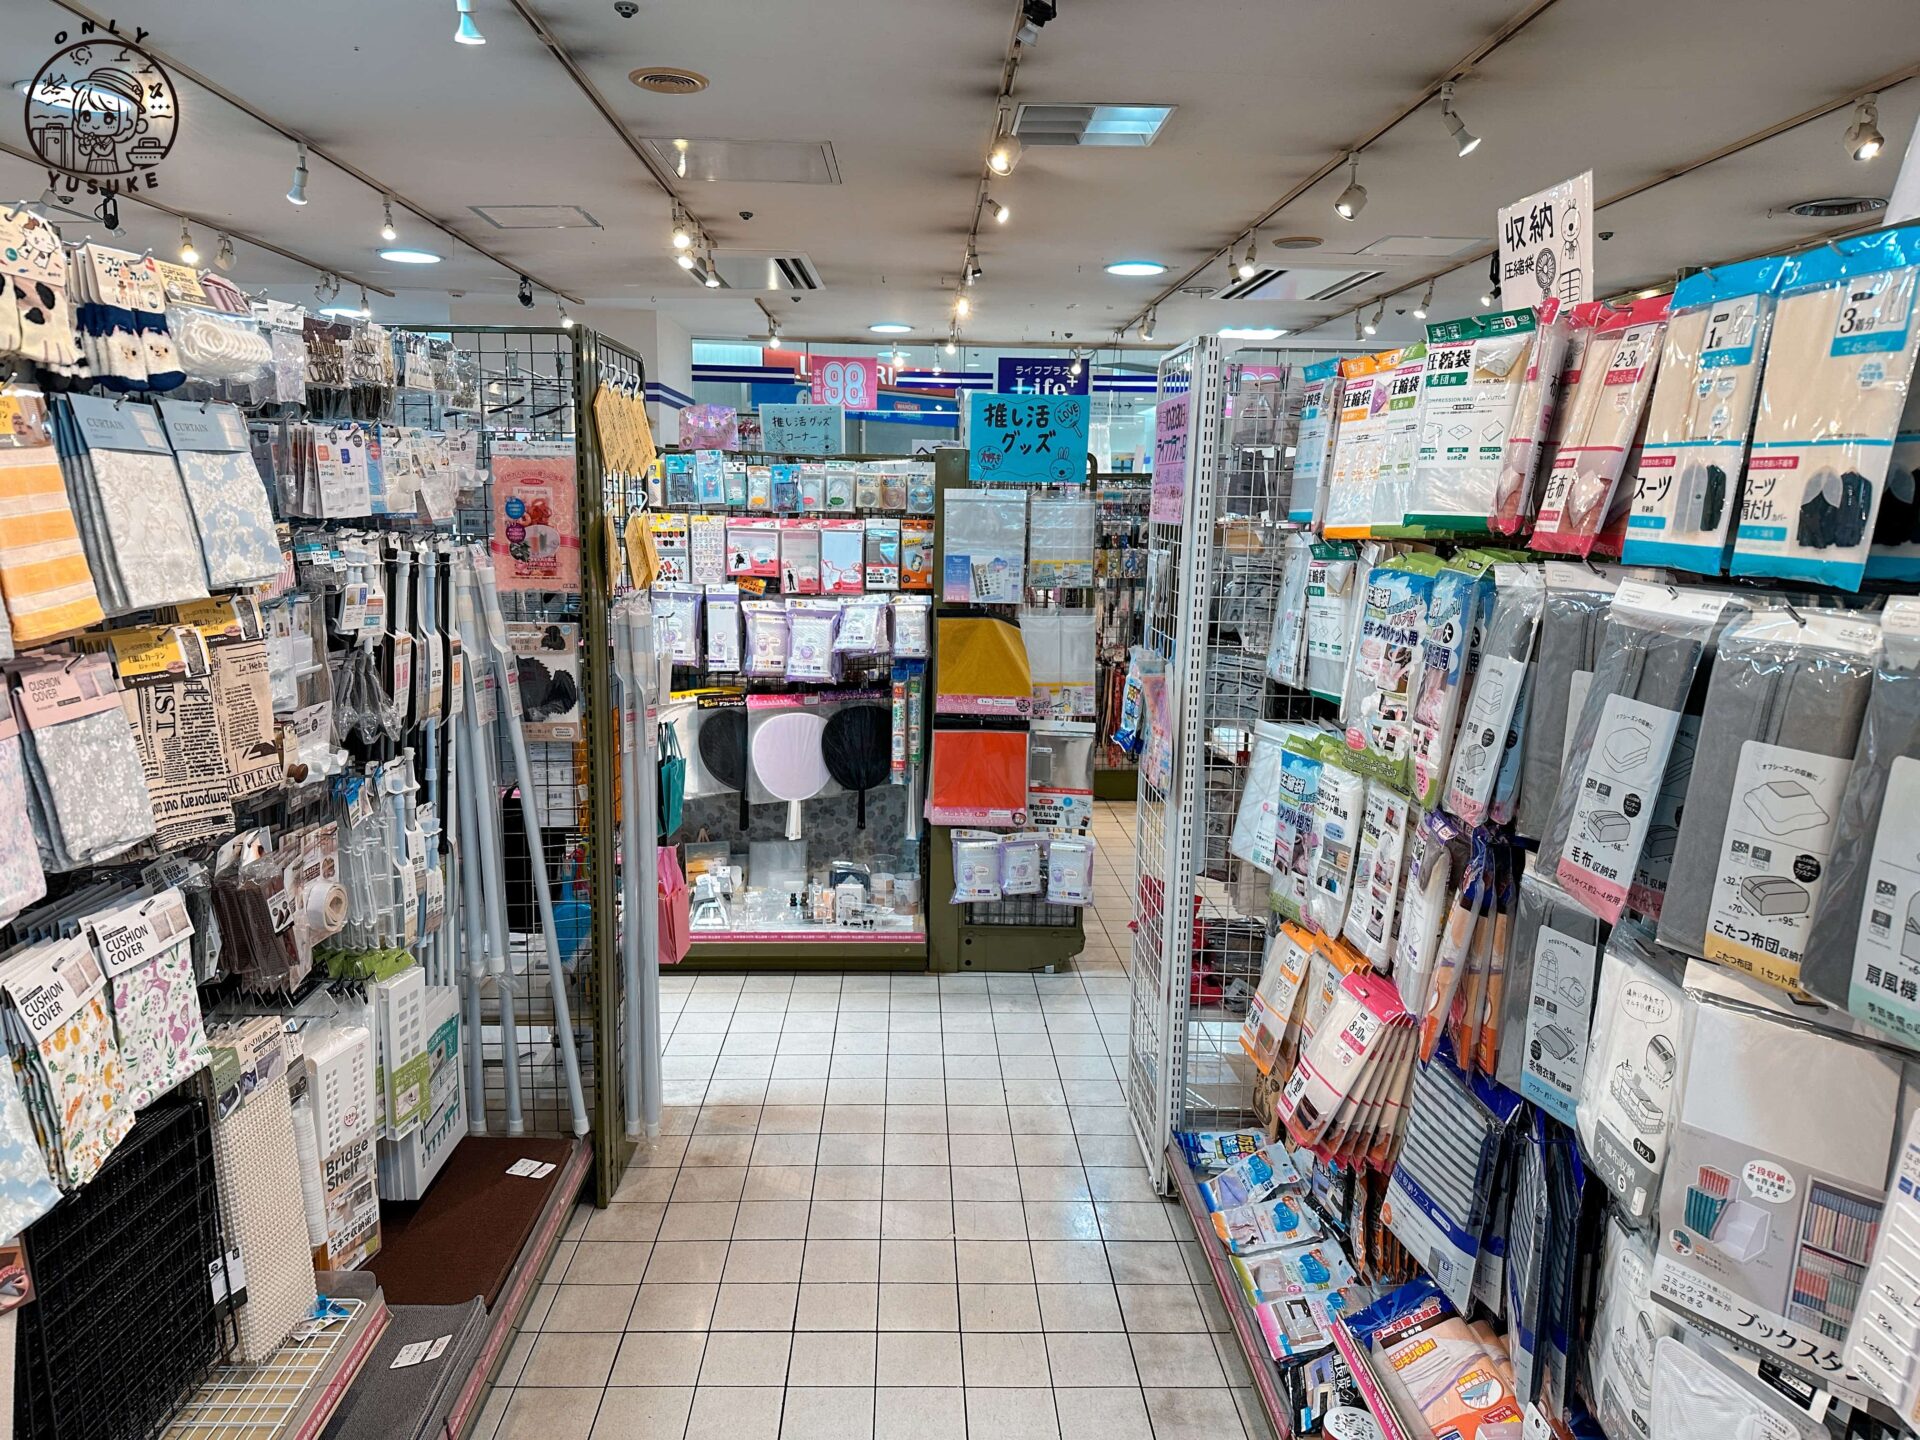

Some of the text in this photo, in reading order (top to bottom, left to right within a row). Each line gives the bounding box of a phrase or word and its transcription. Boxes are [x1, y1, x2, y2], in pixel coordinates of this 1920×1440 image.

[1505, 202, 1553, 252] 収納
[1504, 254, 1535, 281] 圧縮袋
[1016, 366, 1071, 375] ライフプラス
[1427, 349, 1471, 371] 圧縮袋
[823, 361, 866, 406] 98
[1391, 375, 1420, 396] 圧縮袋
[86, 417, 126, 430] CURTAIN
[772, 416, 832, 428] 推し活グッズ
[984, 403, 1050, 428] 推し活
[1057, 403, 1079, 423] LOVE
[173, 422, 209, 432] CURTAIN
[786, 433, 818, 442] コーナー
[1001, 429, 1056, 455] グッズ
[1546, 474, 1568, 499] 毛布
[1634, 475, 1672, 501] スーツ
[29, 675, 62, 693] CUSHION
[32, 688, 58, 703] COVER
[1571, 845, 1618, 881] 毛布収納袋
[105, 924, 149, 953] CUSHION
[110, 941, 145, 965] COVER
[1714, 950, 1799, 989] こたつ布団 1セット用
[1865, 963, 1918, 1002] 扇風機
[24, 981, 64, 1018] CUSHION
[32, 1001, 64, 1031] COVER
[327, 1139, 369, 1177] Bridge
[327, 1158, 360, 1193] Shelf
[1756, 1185, 1779, 1198] 見える
[330, 1211, 377, 1255] スキマ収納術!!
[1660, 1284, 1704, 1309] 収納できる
[1663, 1273, 1732, 1312] コミック・文庫本が
[1862, 1335, 1894, 1367] Letter
[1857, 1363, 1884, 1392] Stock
